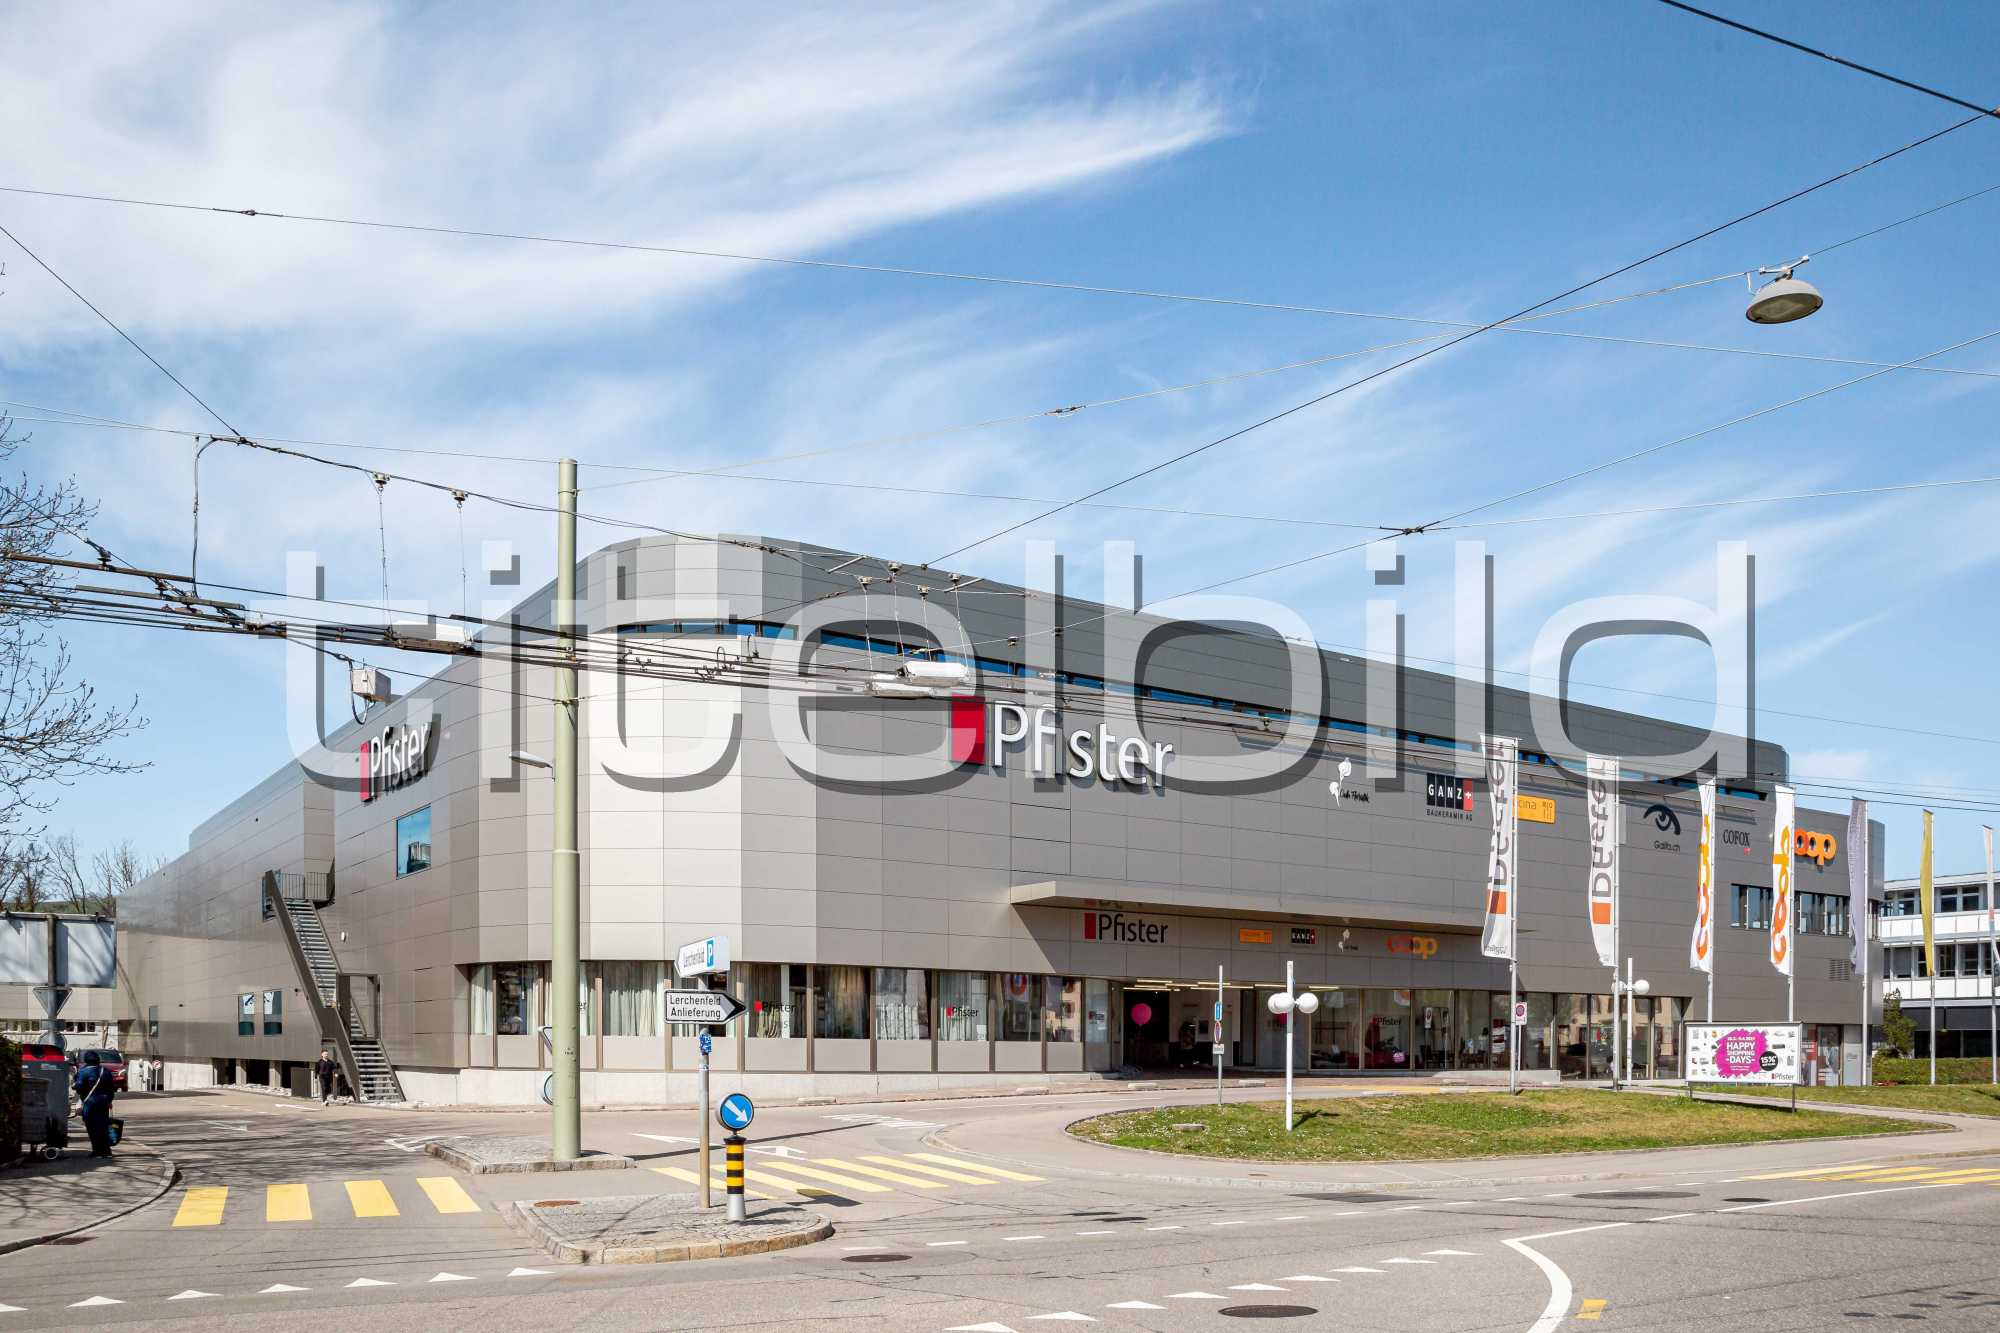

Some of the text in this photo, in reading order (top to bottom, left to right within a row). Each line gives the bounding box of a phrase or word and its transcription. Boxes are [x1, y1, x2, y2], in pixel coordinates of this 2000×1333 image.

[992, 700, 1173, 787] Pfister
[370, 722, 429, 797] Pfister
[1723, 829, 1751, 847] COFOX
[1098, 913, 1168, 943] Pfister
[669, 994, 721, 1006] Lerchenfeld
[670, 1007, 721, 1020] Anlieferung
[1726, 1041, 1755, 1050] HAPPY
